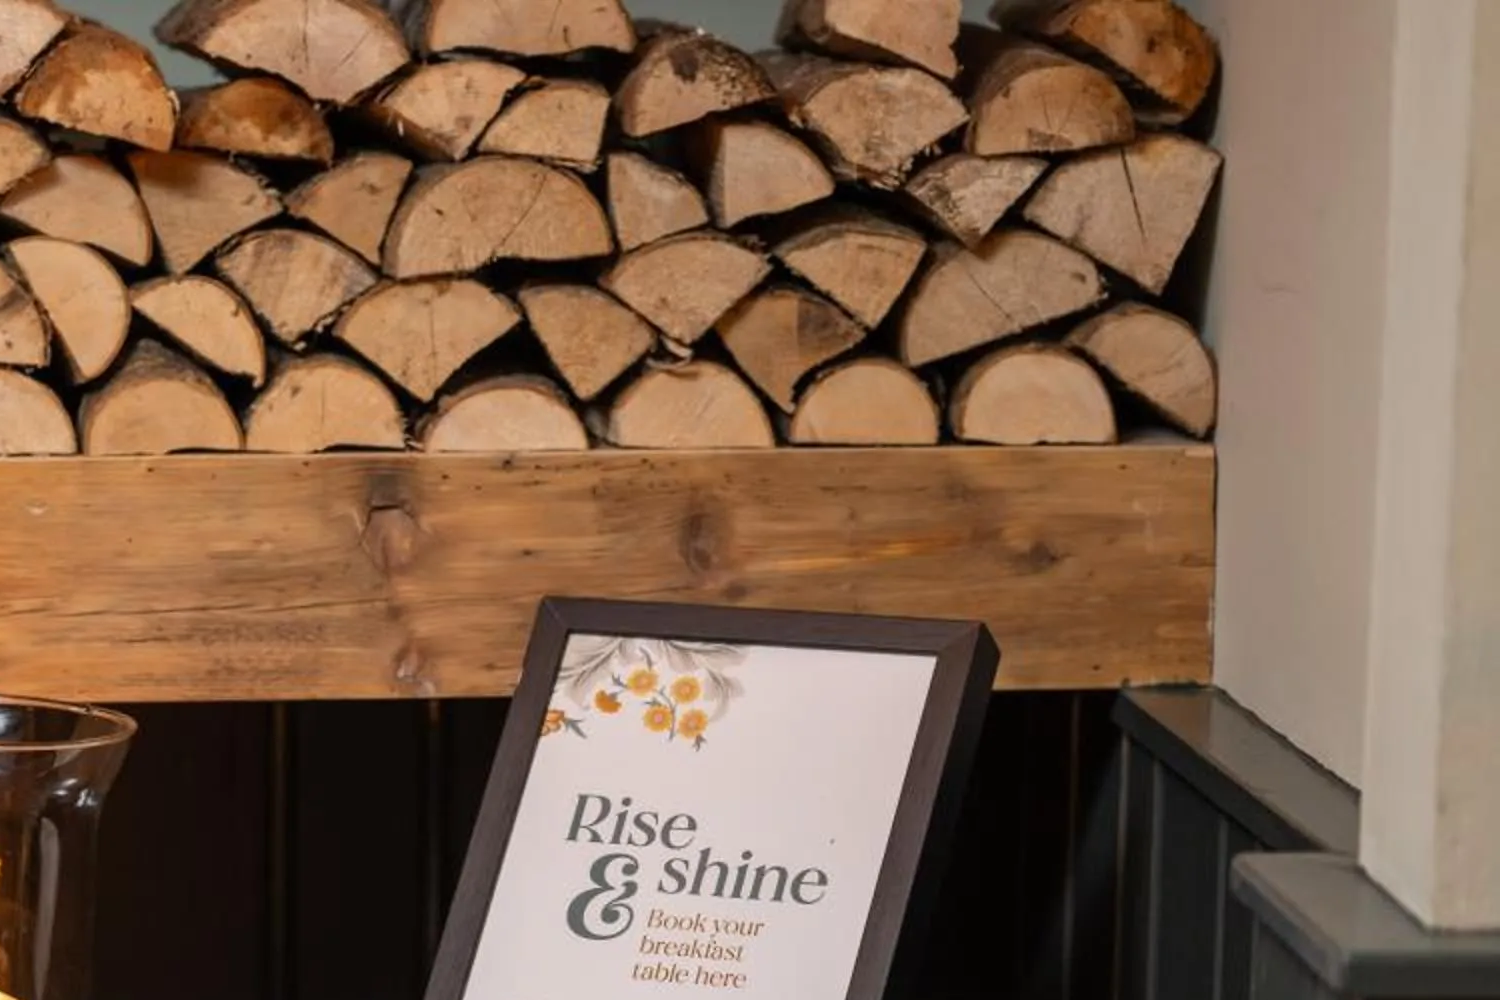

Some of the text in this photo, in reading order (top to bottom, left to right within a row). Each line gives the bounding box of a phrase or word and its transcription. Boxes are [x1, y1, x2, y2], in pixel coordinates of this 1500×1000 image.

[564, 793, 697, 851] Rise
[566, 847, 828, 940] & shine
[647, 907, 765, 939] Book your
[639, 934, 744, 962] breakfast
[631, 962, 747, 989] table here
